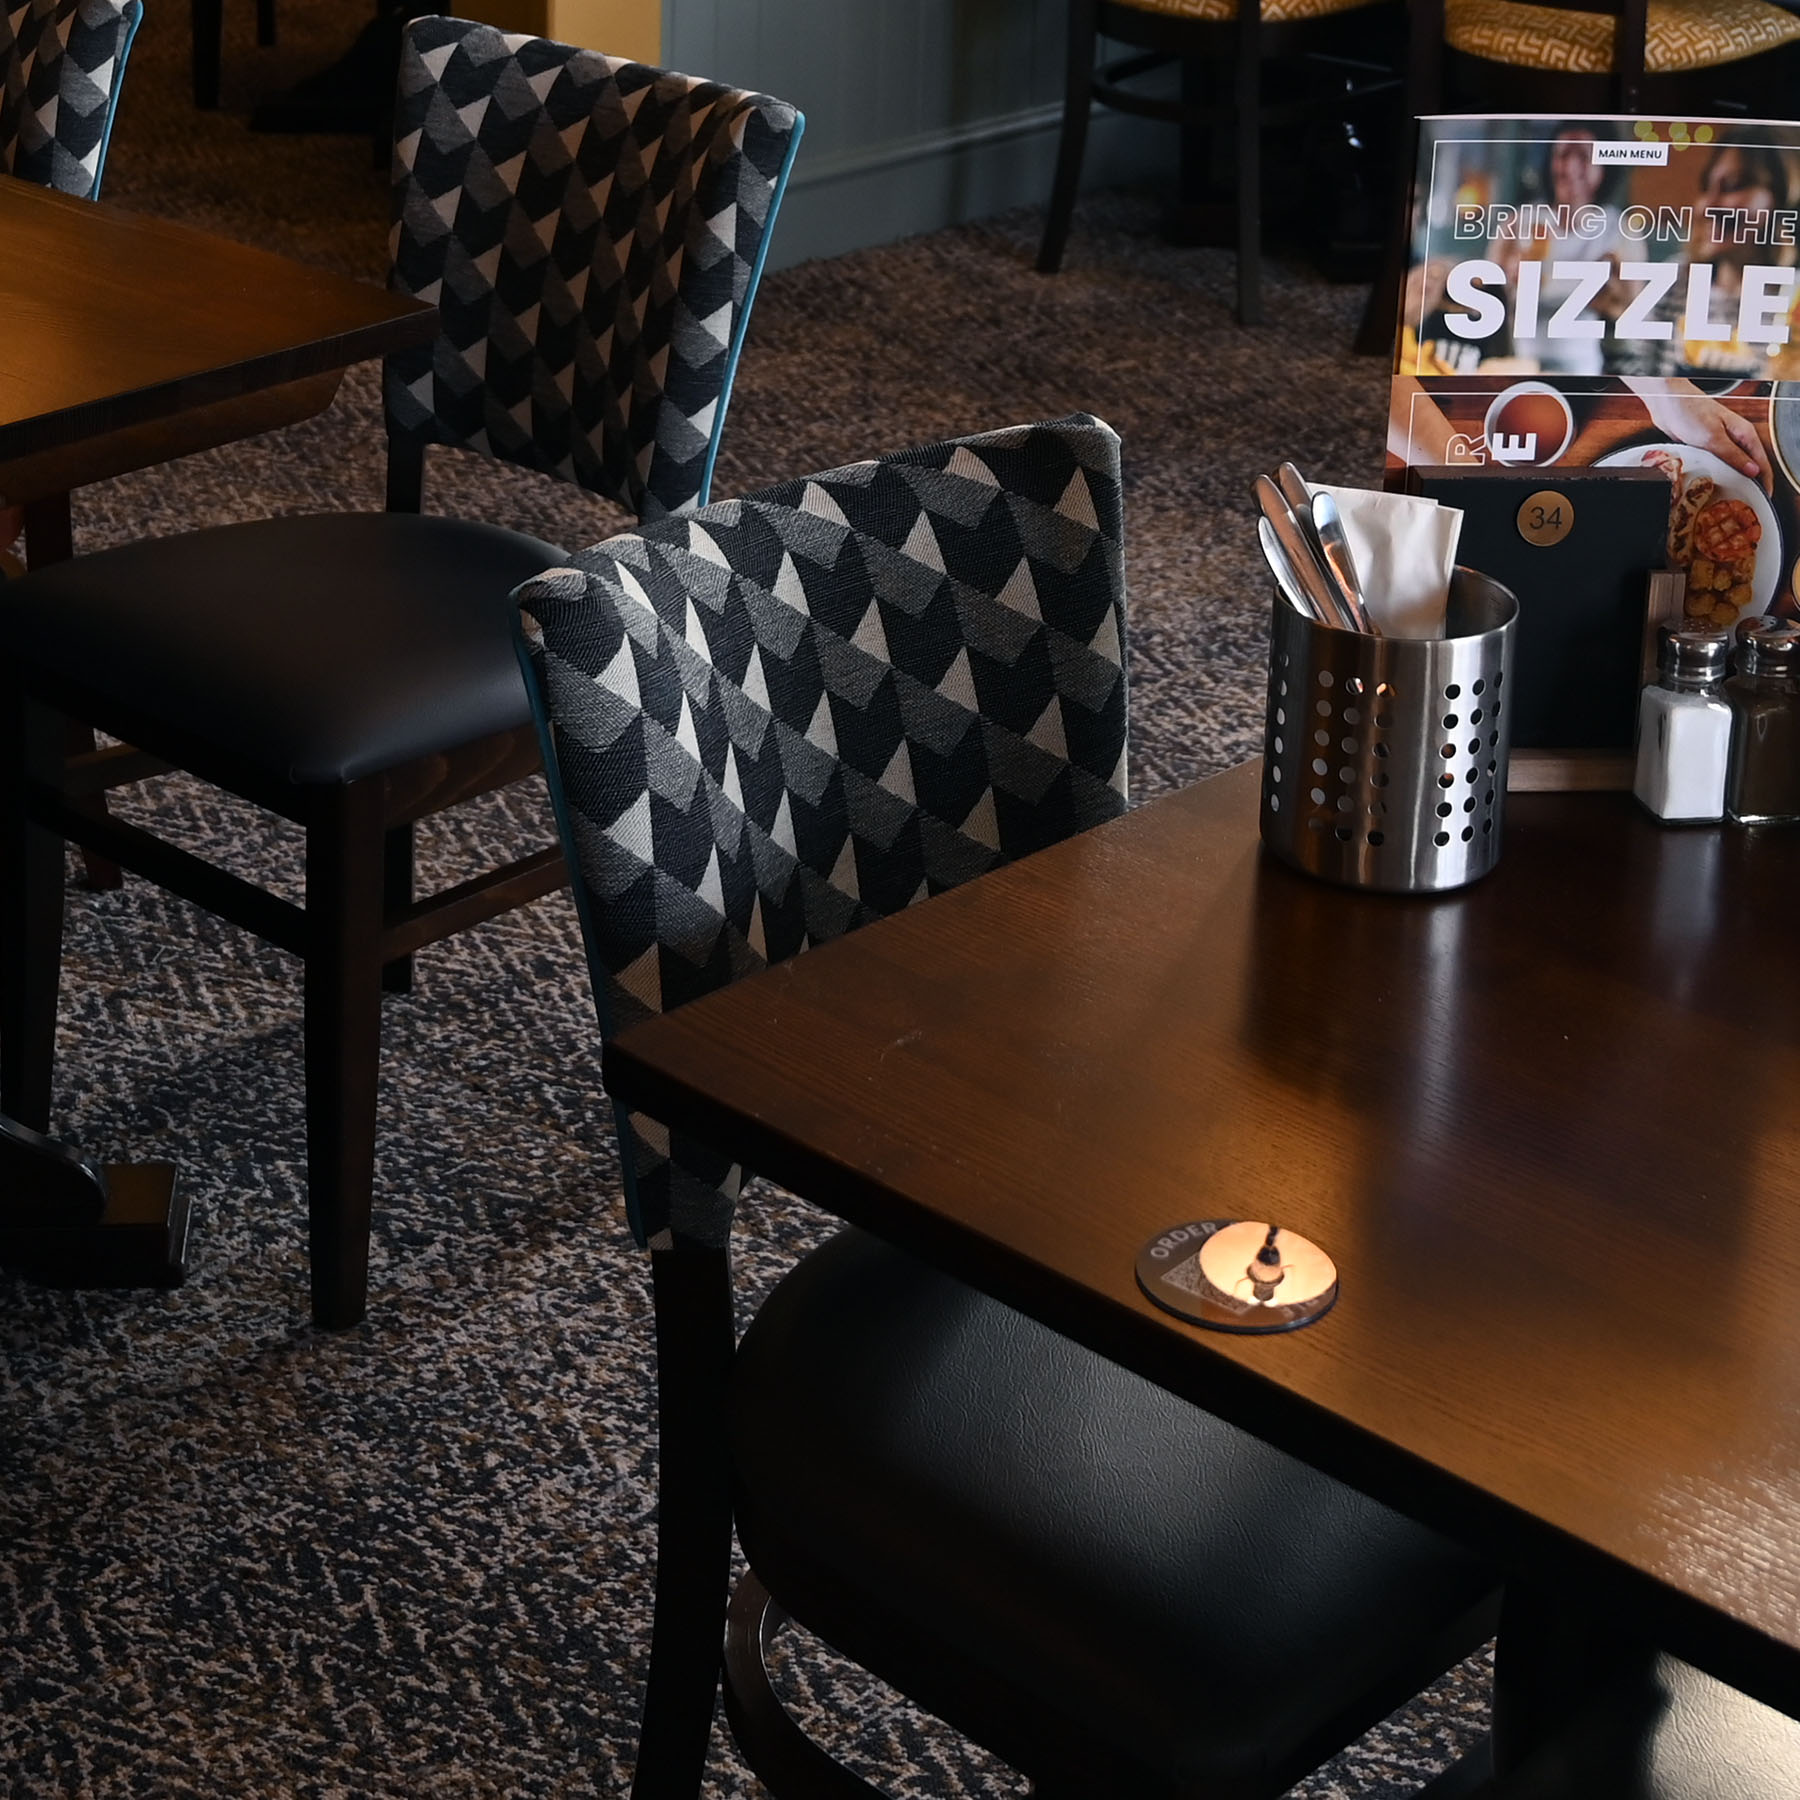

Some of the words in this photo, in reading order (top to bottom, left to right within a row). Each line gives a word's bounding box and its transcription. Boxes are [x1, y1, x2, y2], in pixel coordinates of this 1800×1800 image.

[1598, 148, 1627, 159] MAIN
[1630, 149, 1662, 160] MENU
[1454, 204, 1607, 240] BRING
[1618, 205, 1693, 242] ON
[1705, 207, 1798, 246] THE
[1444, 259, 1796, 344] SIZZLE
[1529, 507, 1562, 530] 34
[1150, 1221, 1218, 1259] ORDER
